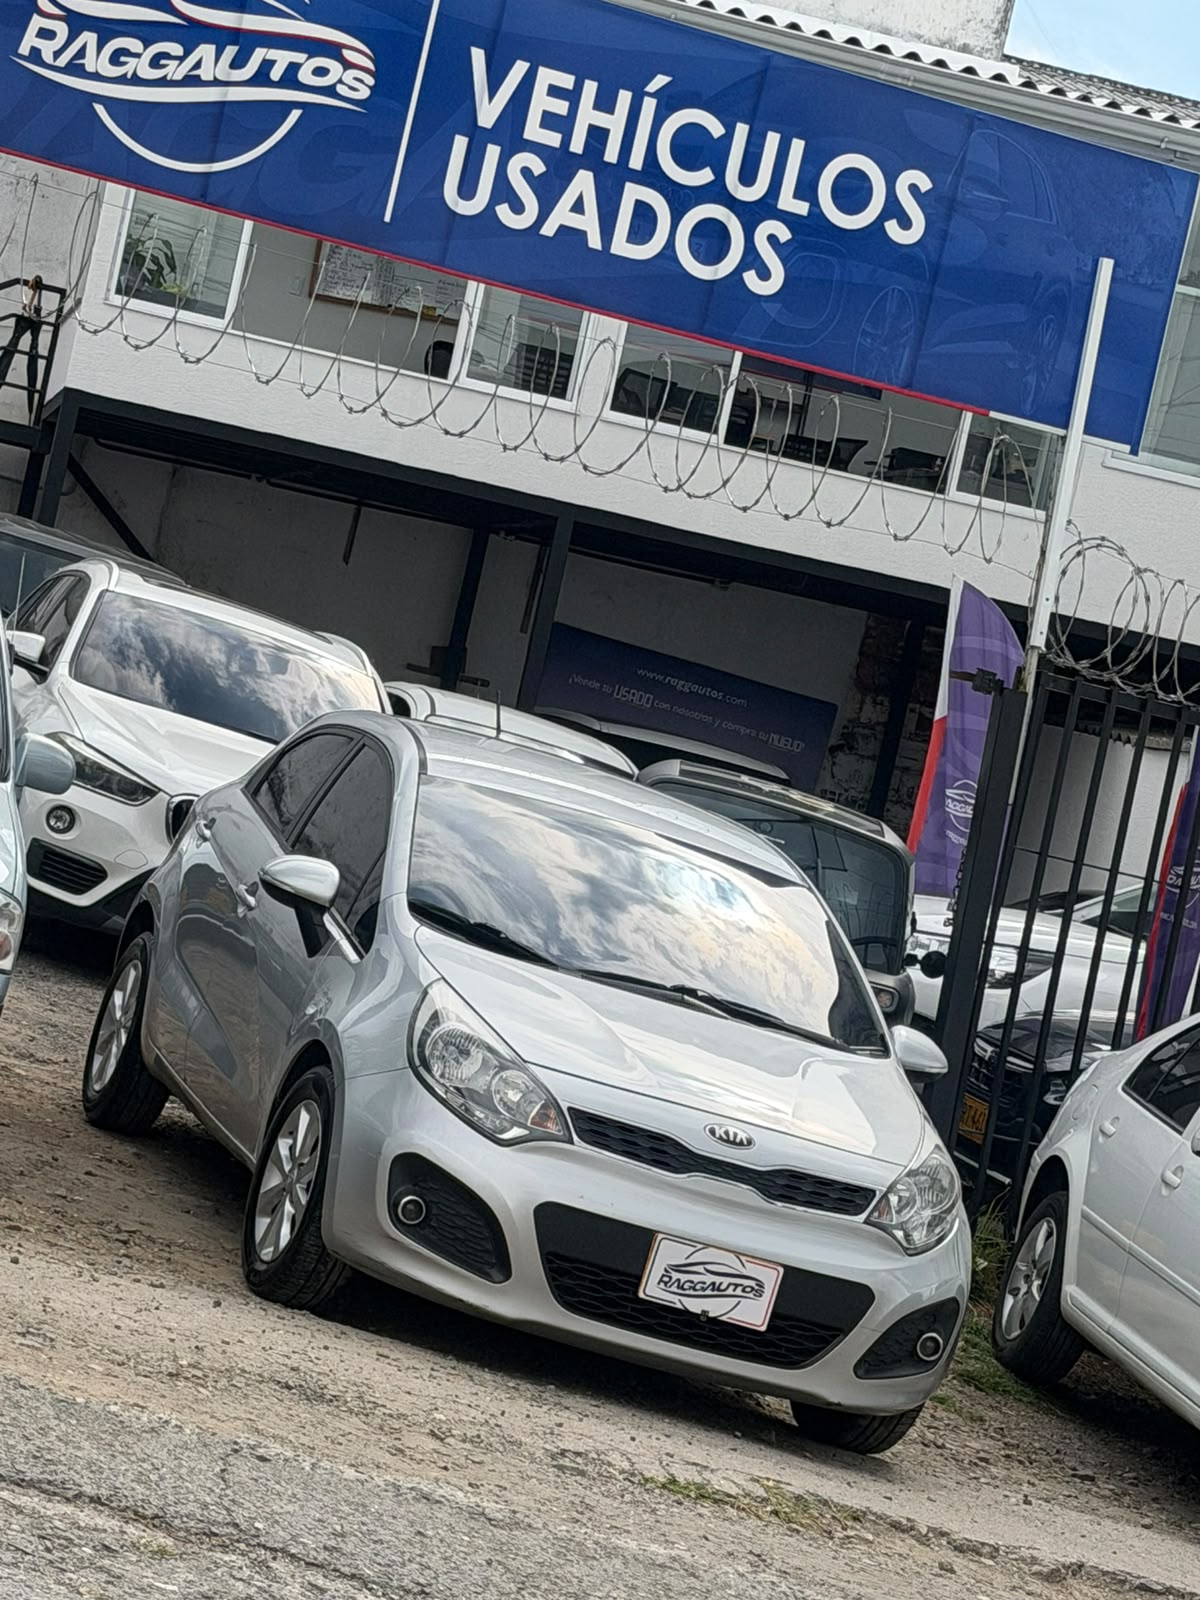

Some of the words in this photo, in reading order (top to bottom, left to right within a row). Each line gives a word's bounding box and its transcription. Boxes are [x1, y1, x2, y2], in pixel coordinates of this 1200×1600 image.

[17, 12, 376, 101] RAGGAUTOS
[470, 46, 934, 246] VEHÍCULOS
[442, 134, 793, 297] USADOS
[613, 684, 654, 708] USADO
[654, 699, 671, 711] con
[672, 705, 713, 724] nosotros
[636, 667, 748, 708] www.raggautos.com
[711, 1125, 752, 1147] KIA
[656, 1272, 766, 1299] RAGGAUTOS
